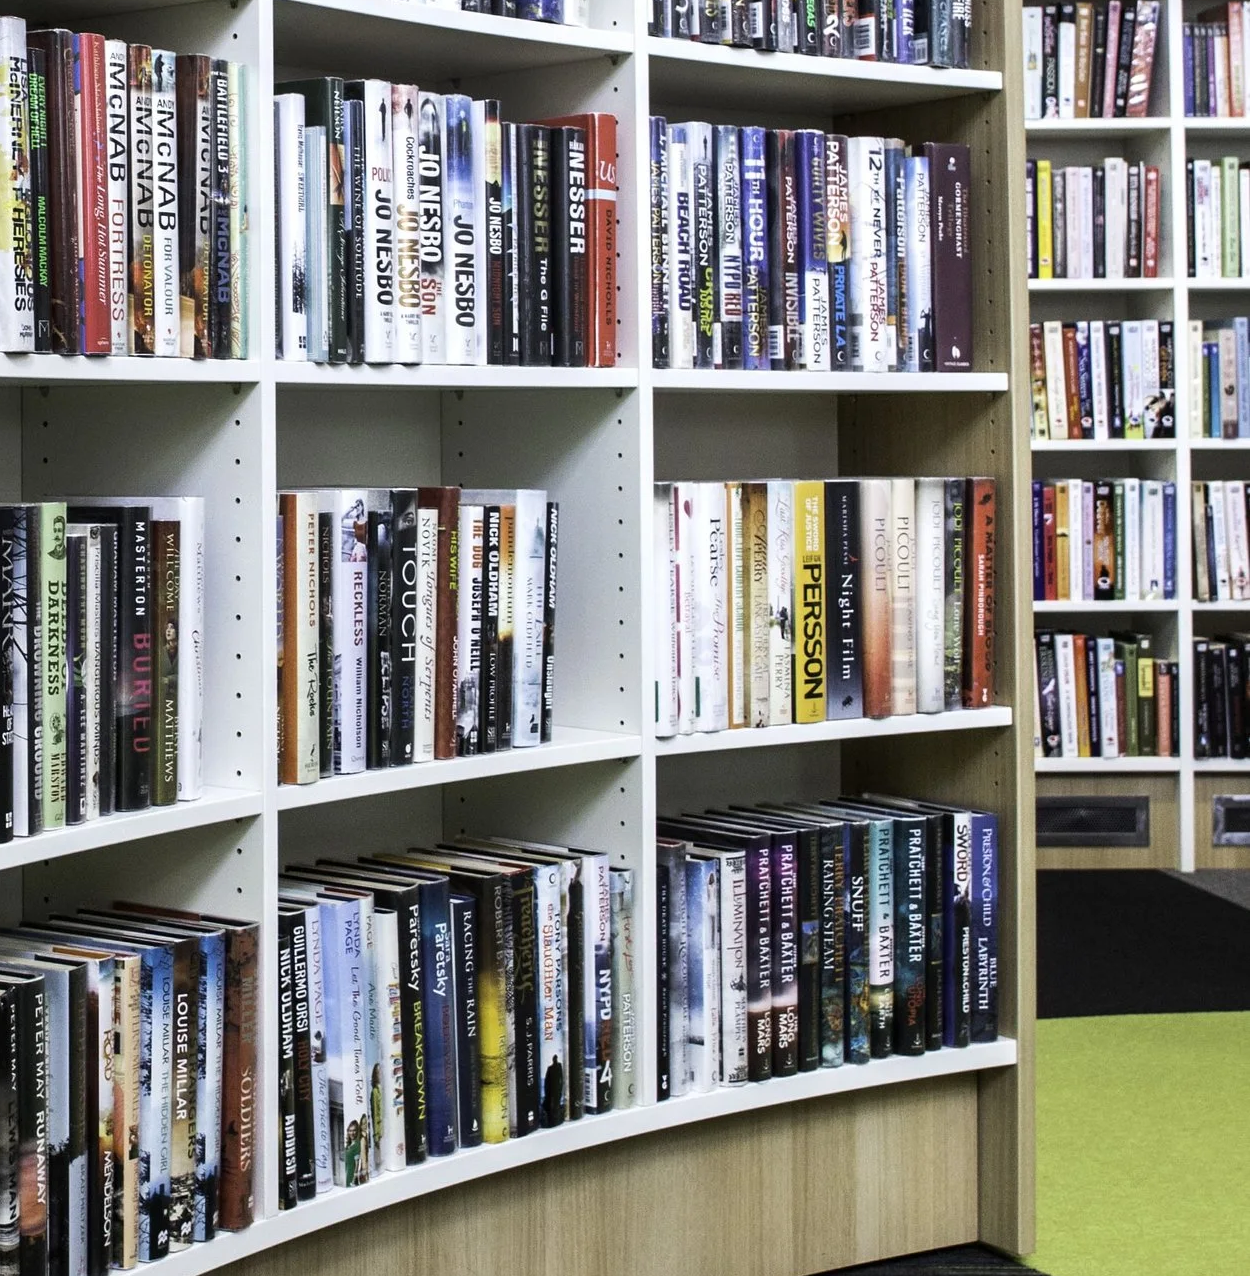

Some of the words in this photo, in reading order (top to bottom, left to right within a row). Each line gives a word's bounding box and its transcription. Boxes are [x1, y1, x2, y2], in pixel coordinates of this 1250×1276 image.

[109, 63, 126, 181] McNAB
[136, 107, 154, 228] McNAB
[156, 109, 176, 230] McNAB
[406, 136, 416, 199] Cockroaches
[419, 145, 439, 177] JO
[38, 196, 46, 244] MALCOLM
[375, 189, 391, 220] JO
[397, 204, 419, 230] JO
[570, 152, 584, 253] NESSER
[698, 165, 707, 266] PATTERSON
[725, 163, 734, 243] PATTERSON
[826, 141, 839, 244] PATTERSON
[839, 165, 847, 222] JAMES
[164, 237, 174, 261] FOR
[420, 185, 441, 262] NESBO
[38, 246, 47, 286] MACKAY
[112, 199, 125, 321] FORTRESS
[143, 235, 153, 316] DETONATOR
[164, 265, 174, 315] VALOUR
[377, 229, 393, 305] NESBO
[398, 239, 420, 307] NESBO
[421, 279, 437, 315] SON
[835, 266, 845, 320] PRIVATE
[837, 326, 846, 347] LA
[136, 522, 145, 616] MASTERTON
[421, 518, 430, 567] NOVIK
[710, 518, 720, 586] Pearse
[754, 543, 763, 584] PERRY
[354, 572, 363, 646] RECKLESS
[402, 543, 416, 662] TOUCH
[804, 564, 823, 699] PERSSON
[839, 575, 853, 627] Night
[48, 581, 59, 696] DARKNESS
[843, 639, 854, 679] Film
[133, 633, 150, 753] BURIED
[355, 657, 363, 694] William
[775, 655, 784, 689] PERRY
[165, 700, 174, 782] MATTHEWS
[50, 753, 60, 803] MARSTON
[957, 825, 966, 881] SWORD
[823, 860, 833, 917] RAISING
[852, 877, 862, 931] SNUFF
[408, 905, 420, 991] Paretsky
[434, 923, 447, 996] Paretsky
[463, 911, 473, 972] RACING
[824, 922, 834, 969] STEAM
[600, 969, 611, 1020] NYPD
[978, 937, 987, 1009] LABYRINTH
[35, 994, 44, 1058] PETER
[177, 994, 188, 1054] LOUISE
[467, 999, 475, 1037] RAIN
[622, 994, 631, 1071] PATTERSON
[779, 1014, 787, 1048] MARS
[36, 1062, 45, 1099] MAY
[176, 1059, 188, 1119] MILLAR
[413, 1001, 426, 1119] BREAKDOWN
[36, 1111, 46, 1205] RUNAWAY
